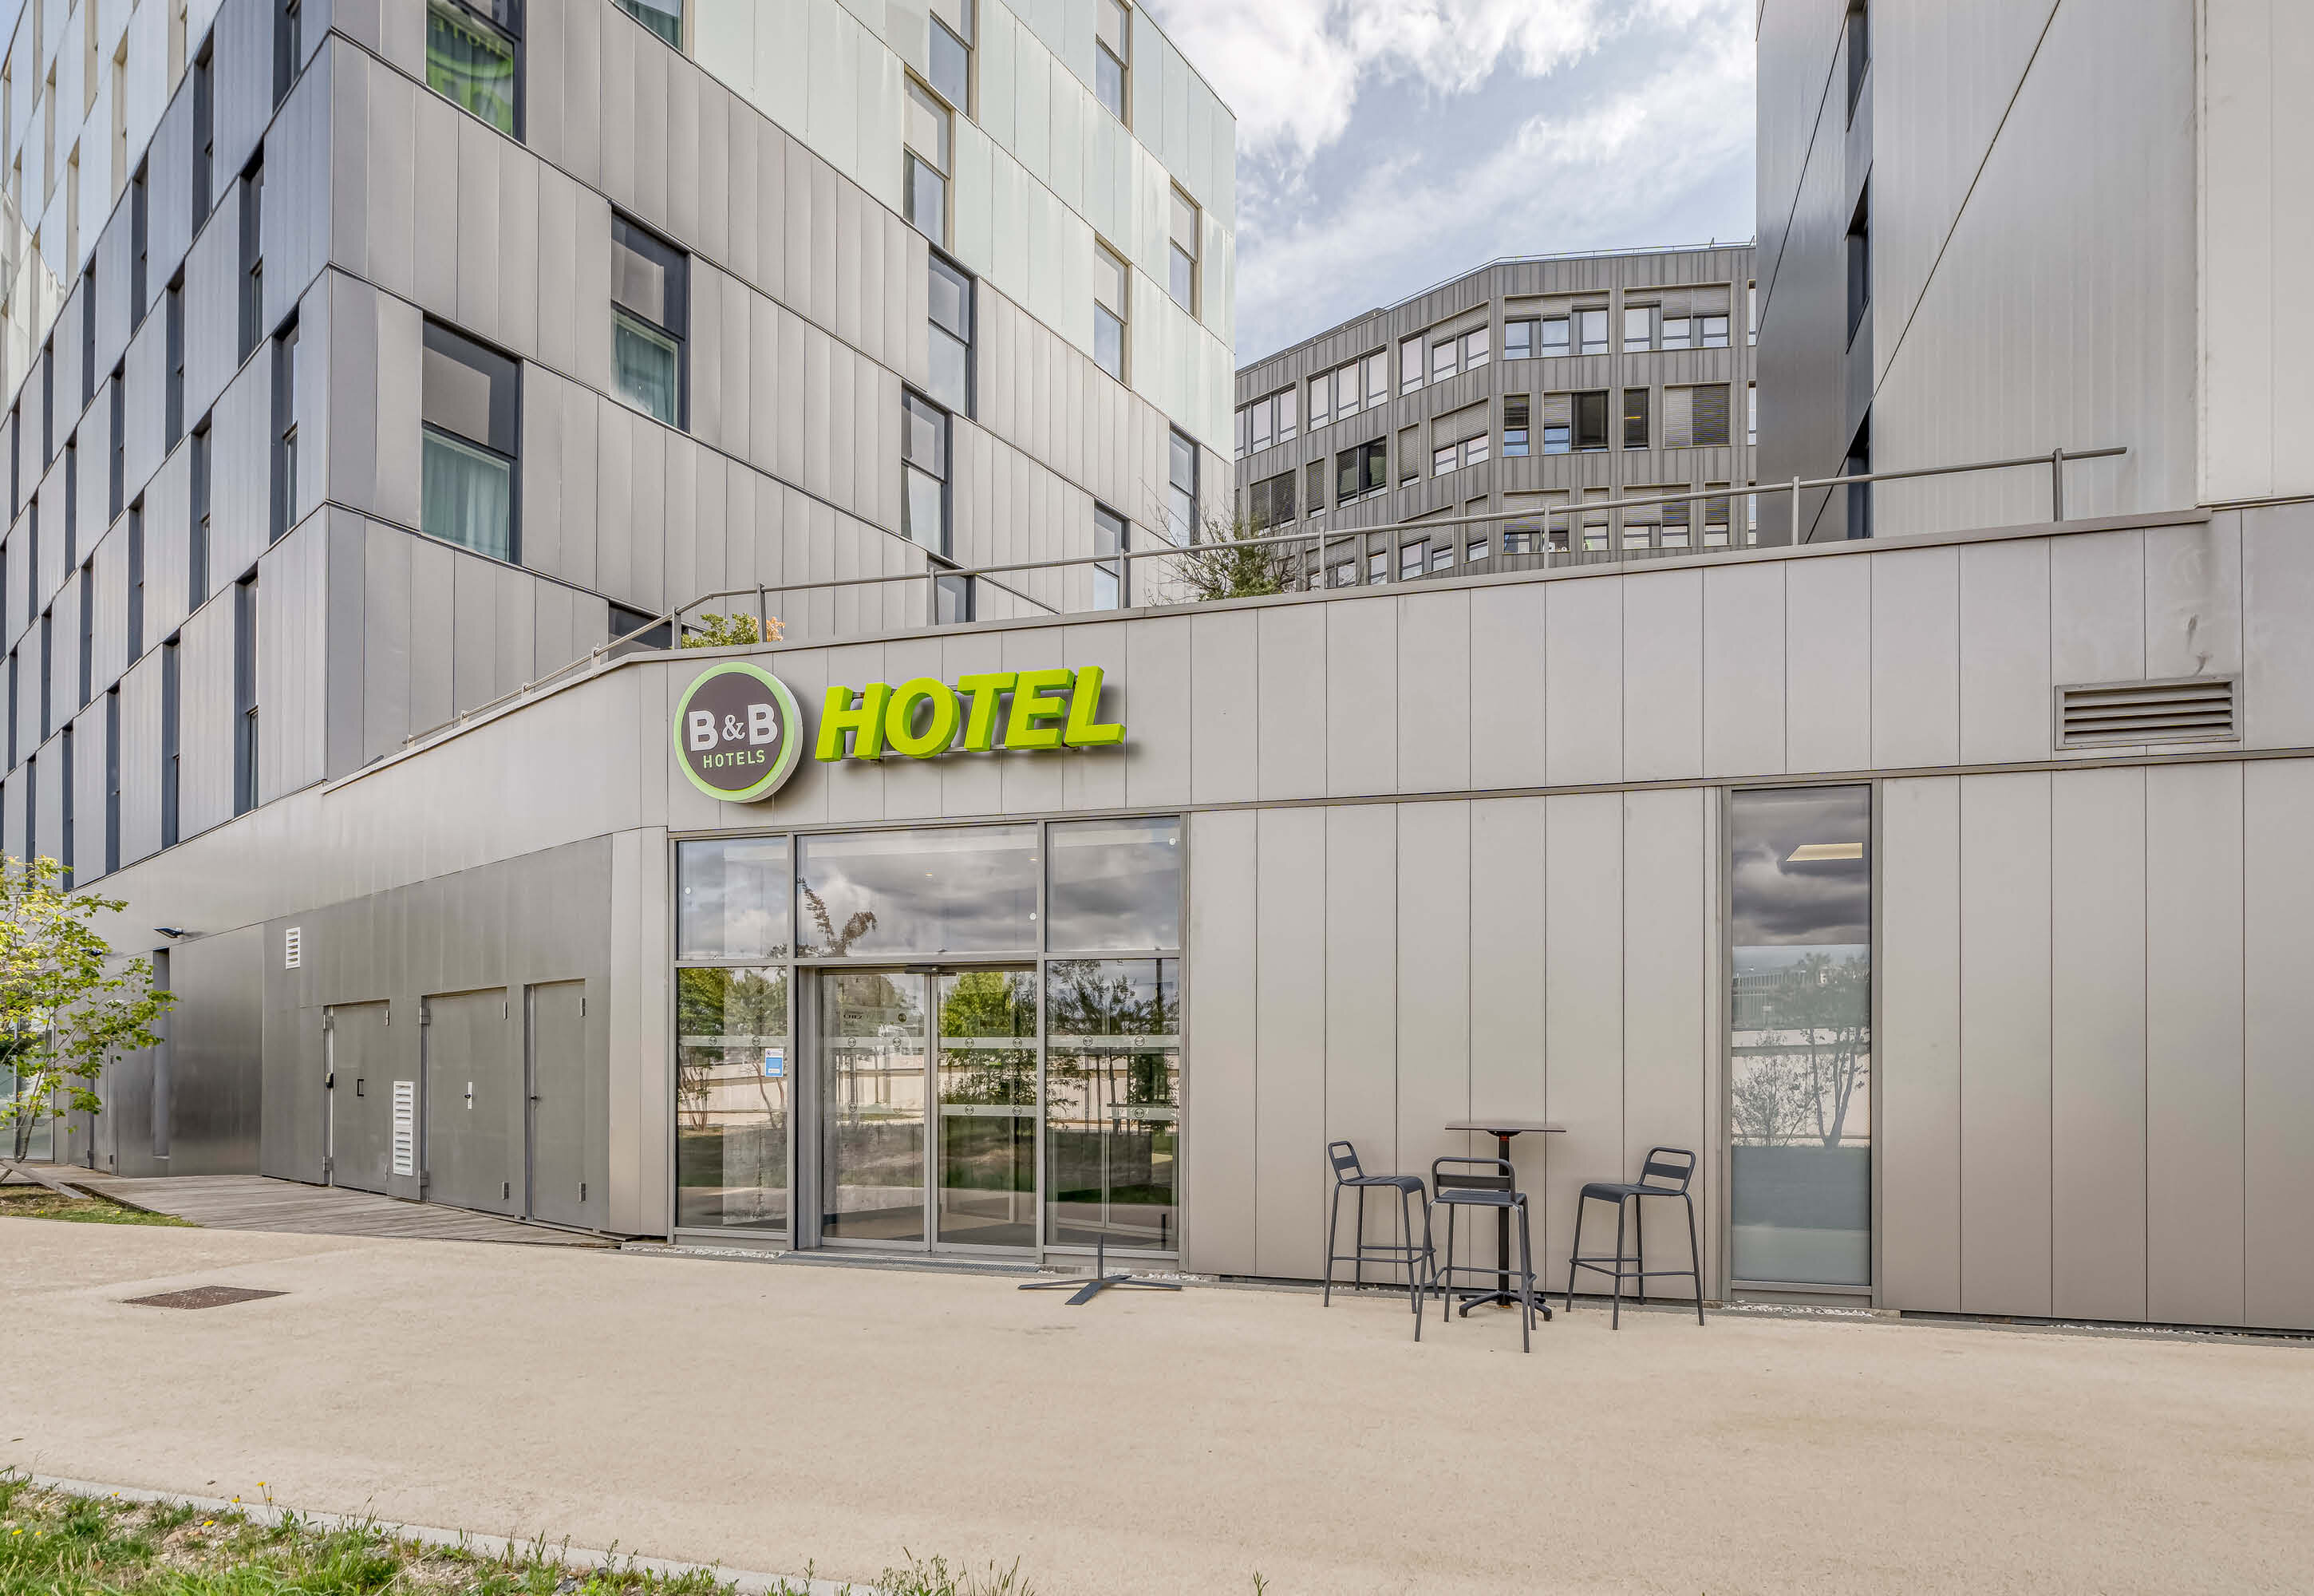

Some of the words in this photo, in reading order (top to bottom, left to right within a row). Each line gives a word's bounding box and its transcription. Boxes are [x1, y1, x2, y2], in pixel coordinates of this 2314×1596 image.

[689, 703, 778, 751] B&B
[815, 666, 1126, 762] HOTEL
[703, 749, 766, 768] HOTELS
